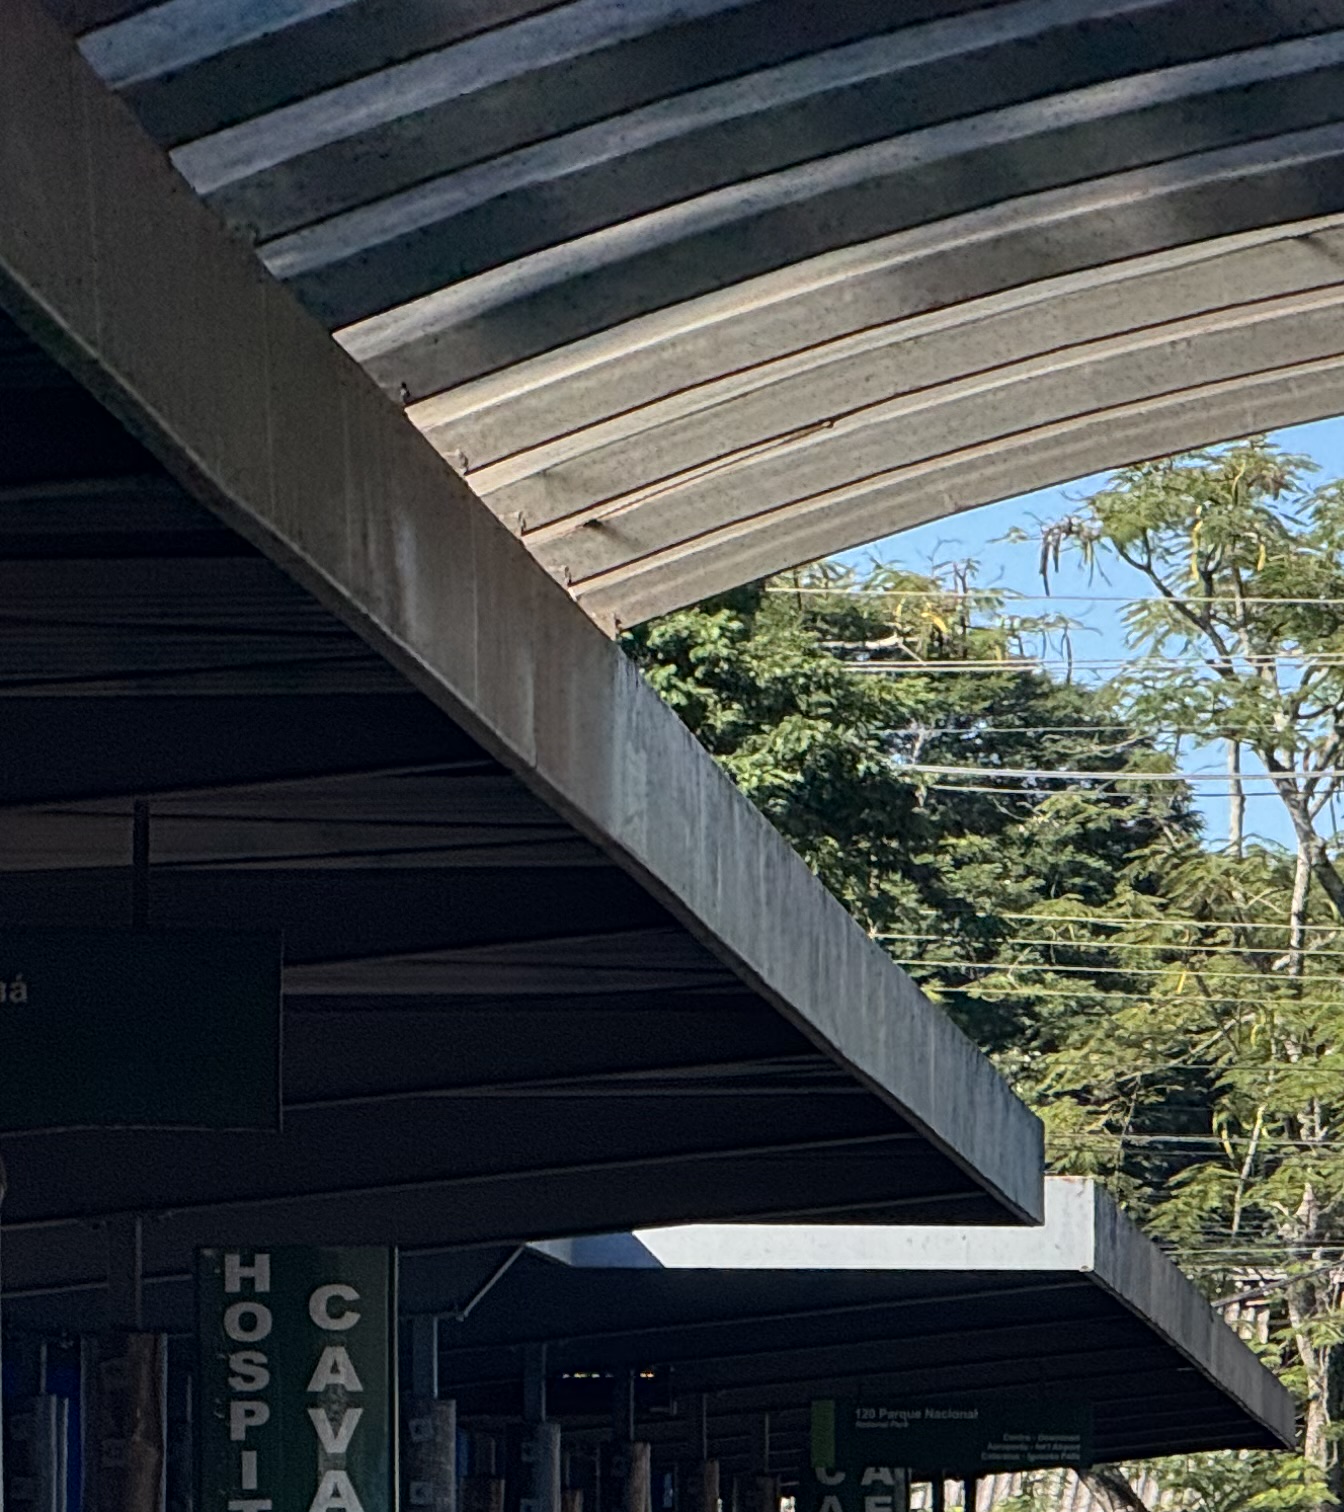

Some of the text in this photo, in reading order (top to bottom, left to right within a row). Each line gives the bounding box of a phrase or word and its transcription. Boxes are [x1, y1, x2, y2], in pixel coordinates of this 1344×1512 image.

[856, 1407, 979, 1423] 120 Parque Nacional
